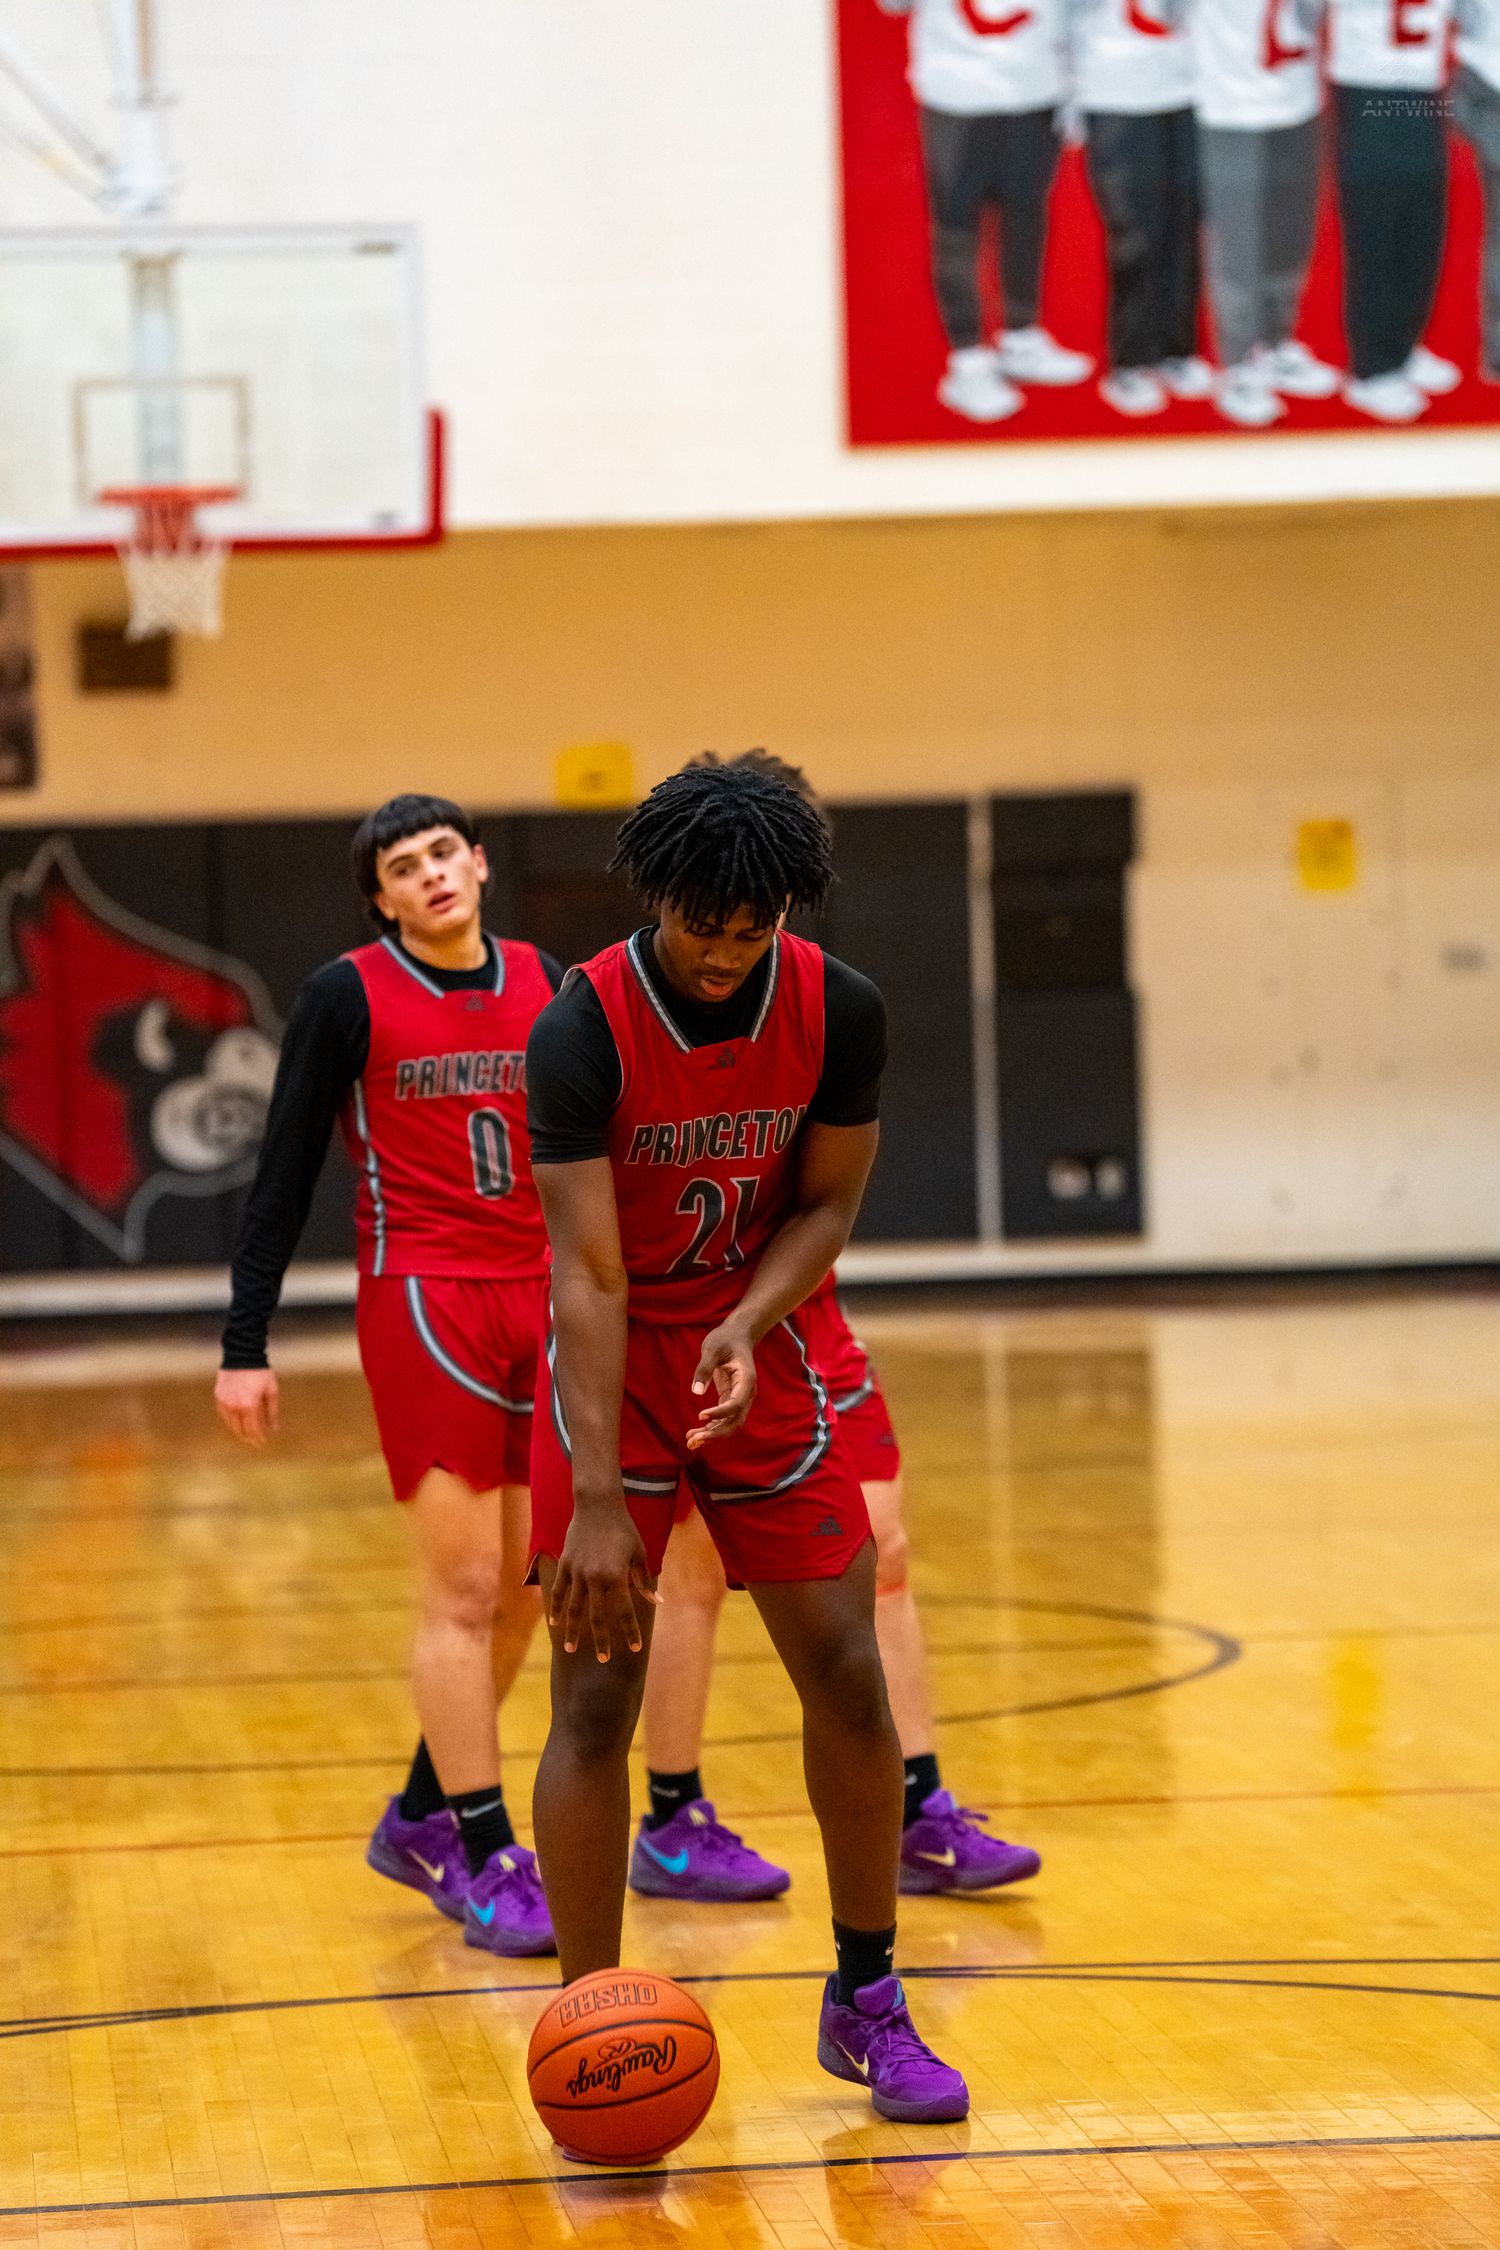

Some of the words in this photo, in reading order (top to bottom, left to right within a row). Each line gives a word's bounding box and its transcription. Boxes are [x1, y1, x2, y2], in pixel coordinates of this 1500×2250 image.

[395, 1050, 529, 1101] PRINCET
[468, 1106, 516, 1200] 0
[665, 1175, 760, 1274] 21
[558, 1983, 658, 2029] OHSAA
[566, 2035, 677, 2098] Rawlings
